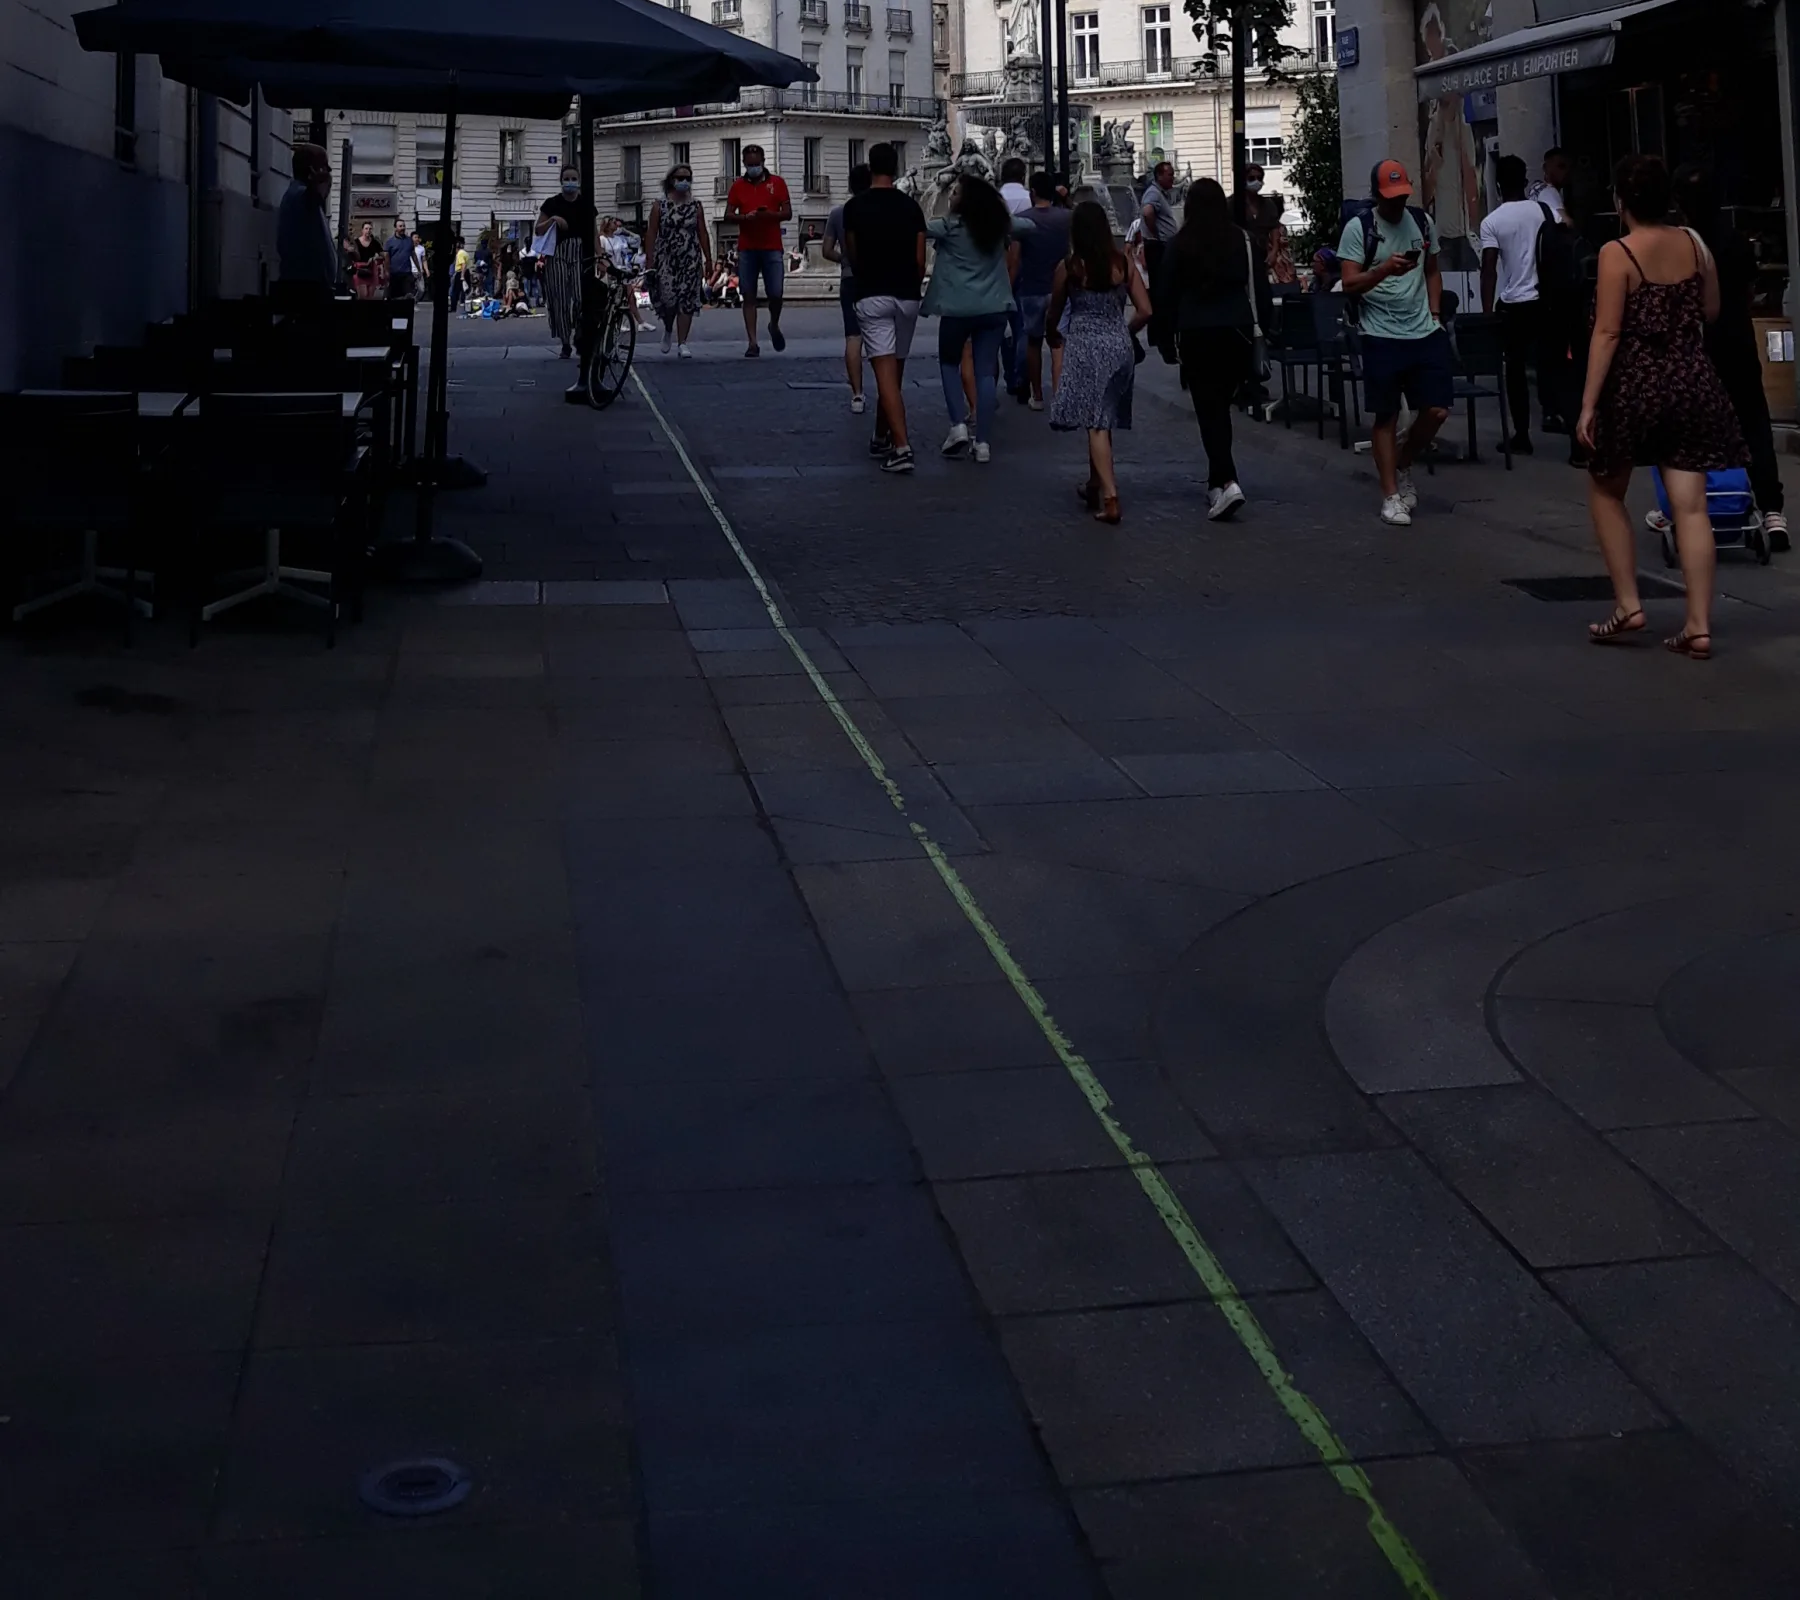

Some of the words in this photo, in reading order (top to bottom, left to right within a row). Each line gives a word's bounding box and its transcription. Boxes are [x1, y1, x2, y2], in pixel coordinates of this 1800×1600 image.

[1463, 67, 1493, 87] PLACE
[1497, 64, 1510, 82] ET
[1523, 48, 1579, 75] EMPORTER
